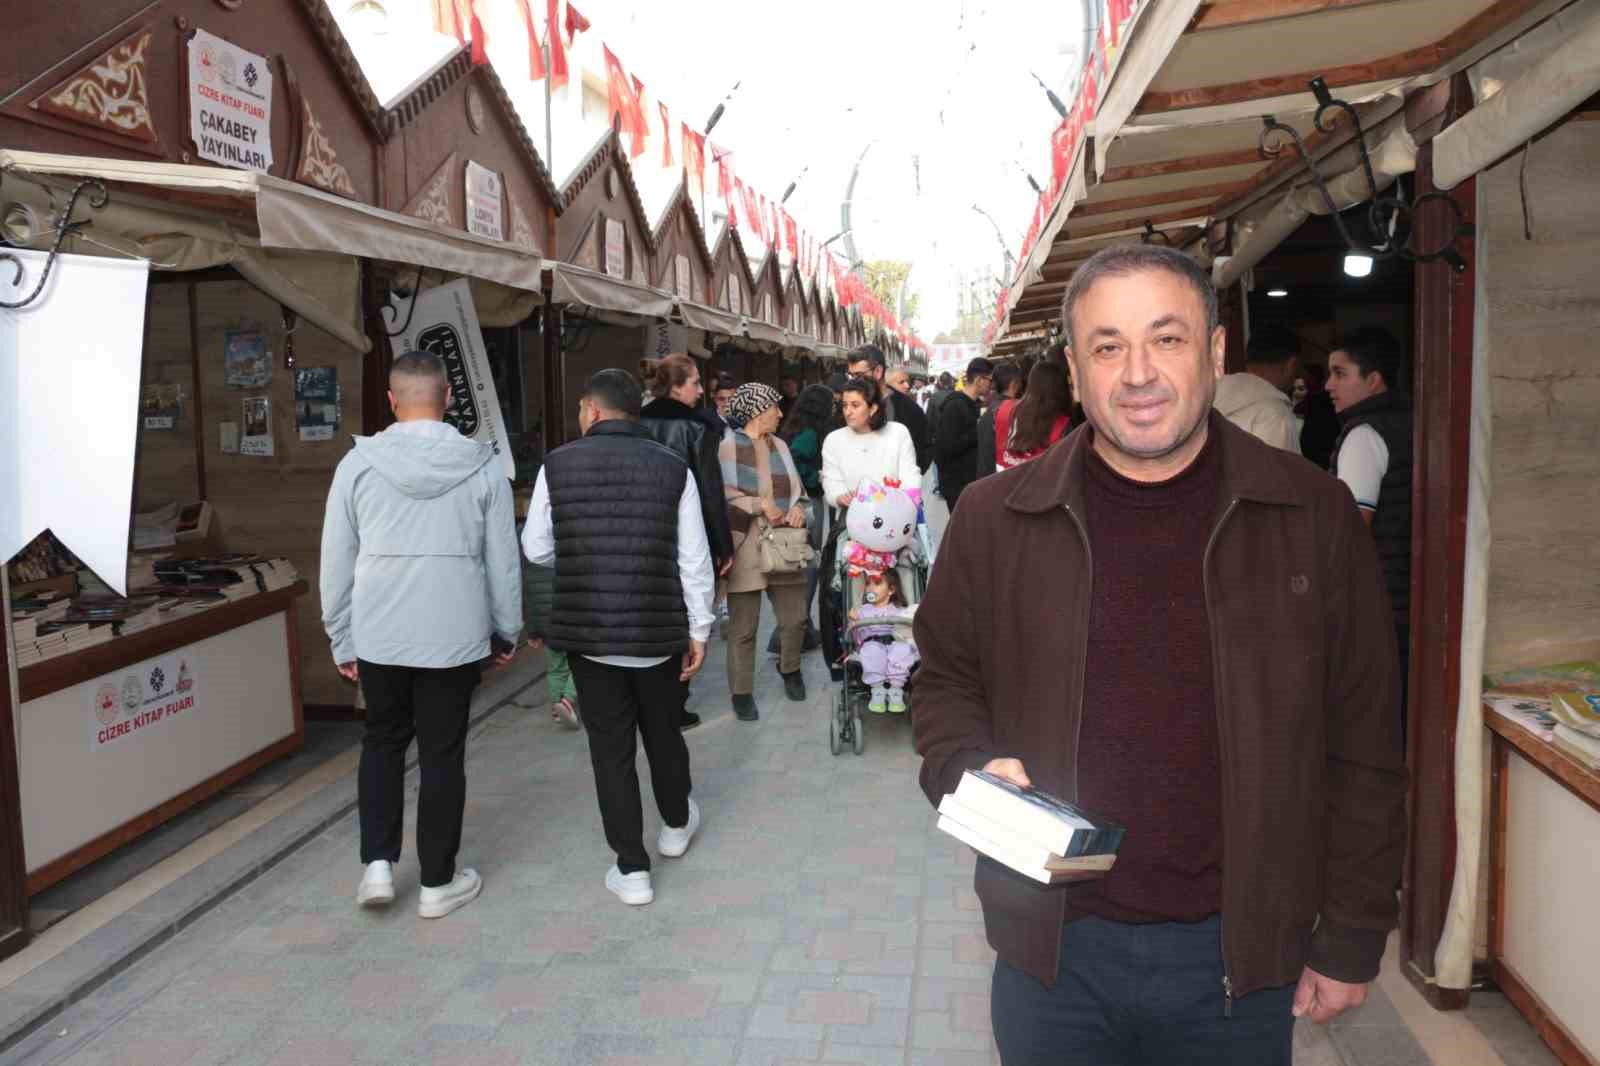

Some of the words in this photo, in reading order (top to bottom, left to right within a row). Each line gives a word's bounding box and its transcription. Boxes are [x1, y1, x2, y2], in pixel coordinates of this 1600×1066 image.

[200, 109, 257, 143] ÇAKABEY
[200, 134, 266, 169] YAYINLARI
[442, 330, 476, 429] YAYINLARI
[165, 695, 194, 717] FUARI
